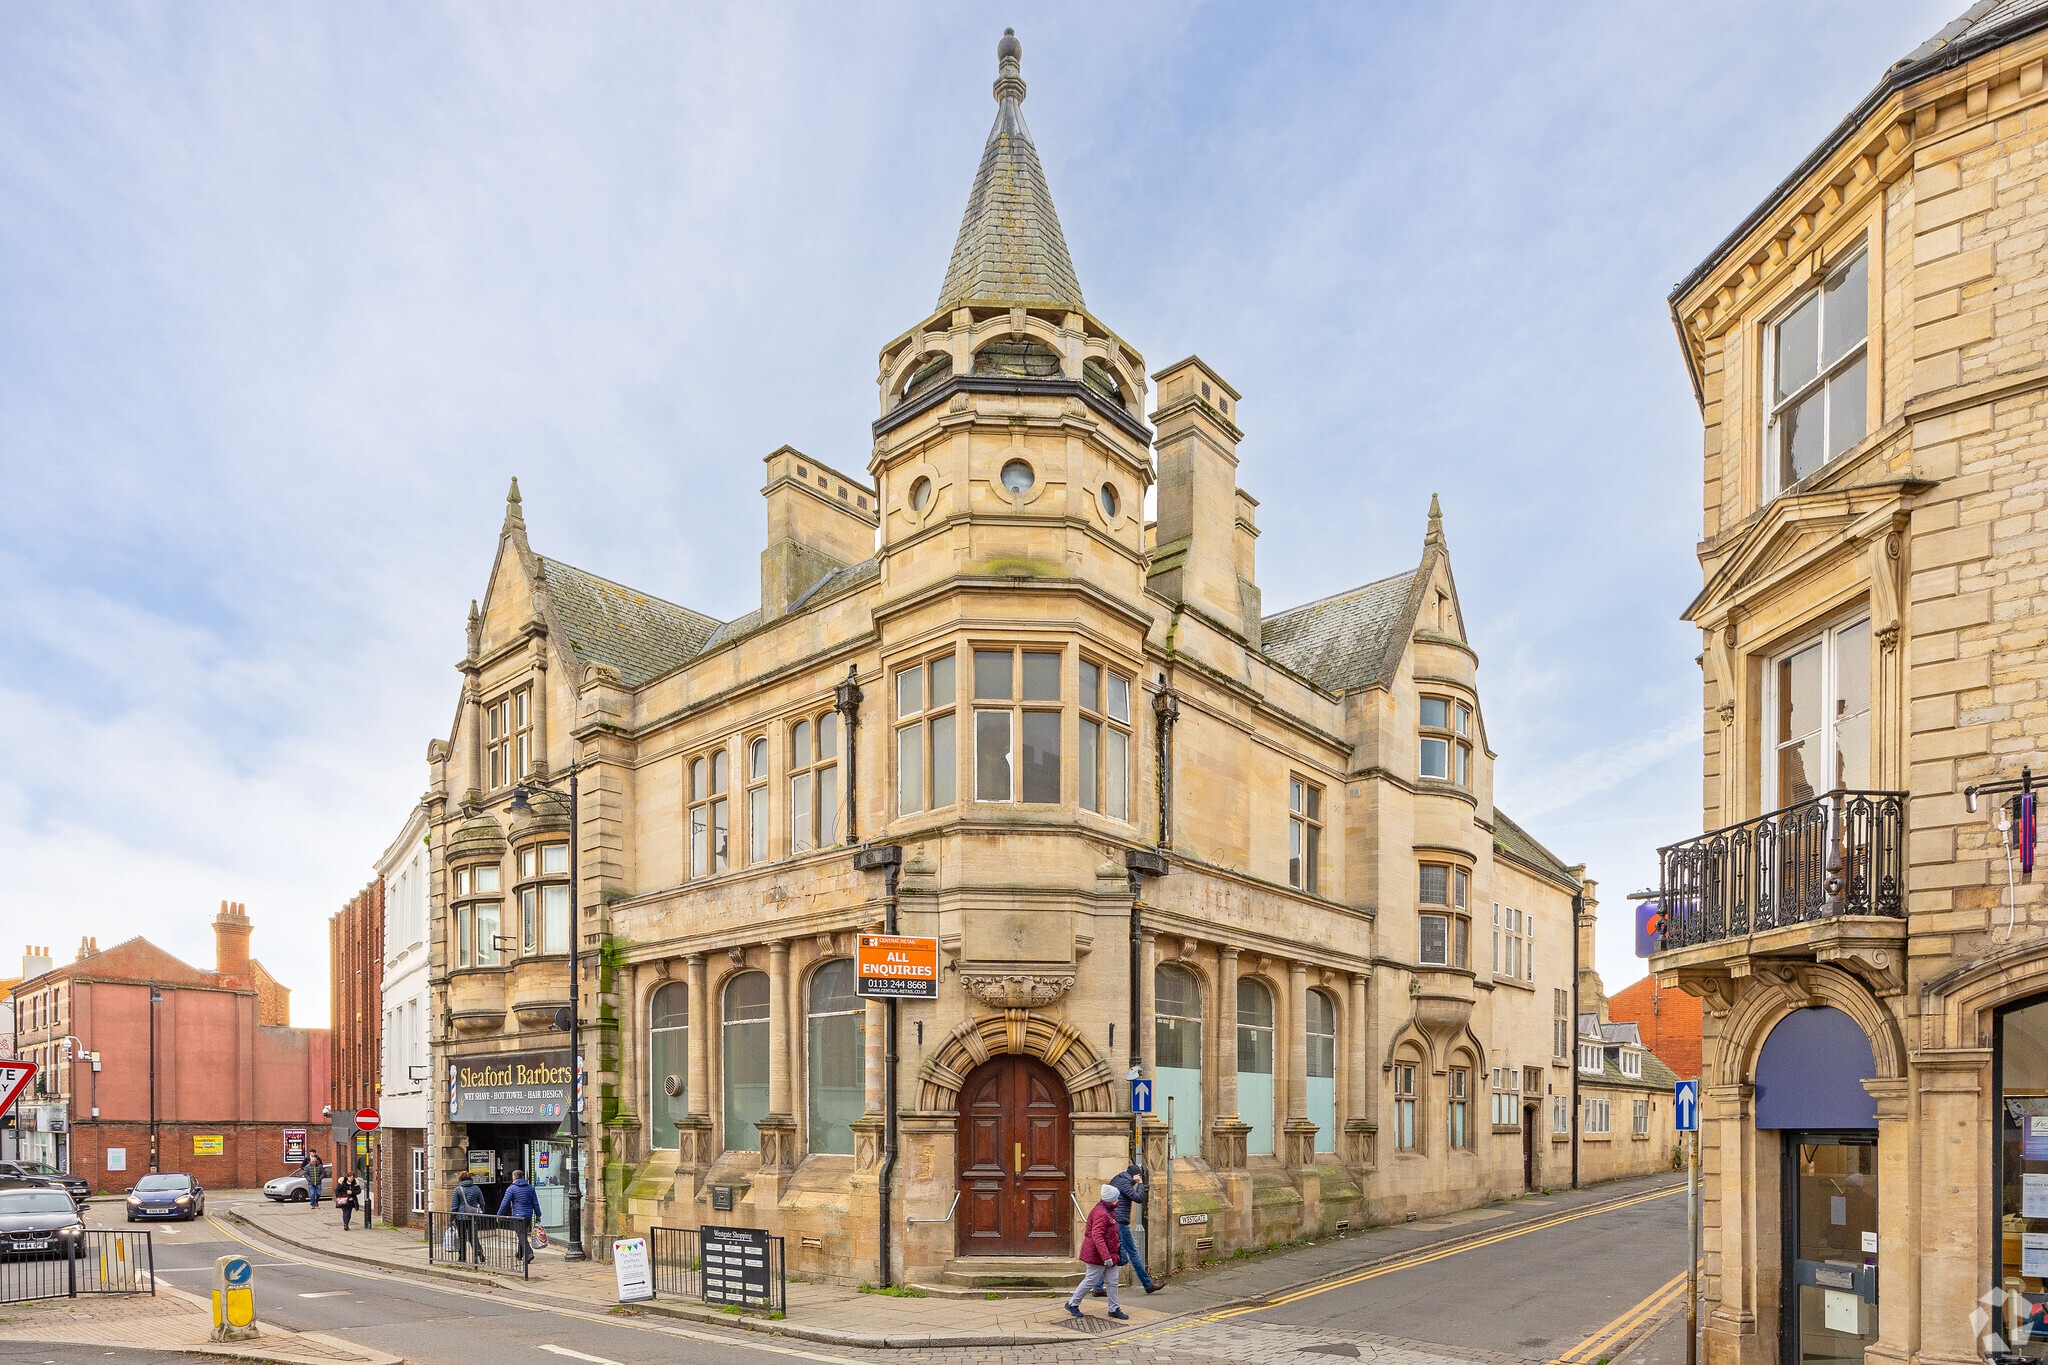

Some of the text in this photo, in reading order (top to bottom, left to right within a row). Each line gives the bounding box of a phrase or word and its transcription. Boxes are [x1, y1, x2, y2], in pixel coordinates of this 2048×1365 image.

[887, 952, 909, 963] ALL
[863, 963, 932, 977] ENQUIRIES
[868, 979, 927, 989] 0113 244 8668
[460, 1062, 572, 1088] Sleaford Barbers
[0, 1084, 9, 1092] Y
[464, 1092, 475, 1101] WET
[475, 1091, 490, 1100] SHAVE
[493, 1091, 506, 1100] HOT
[506, 1091, 524, 1099] TOWEL
[527, 1090, 541, 1099] HAIR
[542, 1089, 564, 1098] DESIGN
[515, 1105, 534, 1114] 652220
[1181, 1214, 1206, 1224] WESTGATE
[713, 1229, 753, 1241] Westgate Shopping
